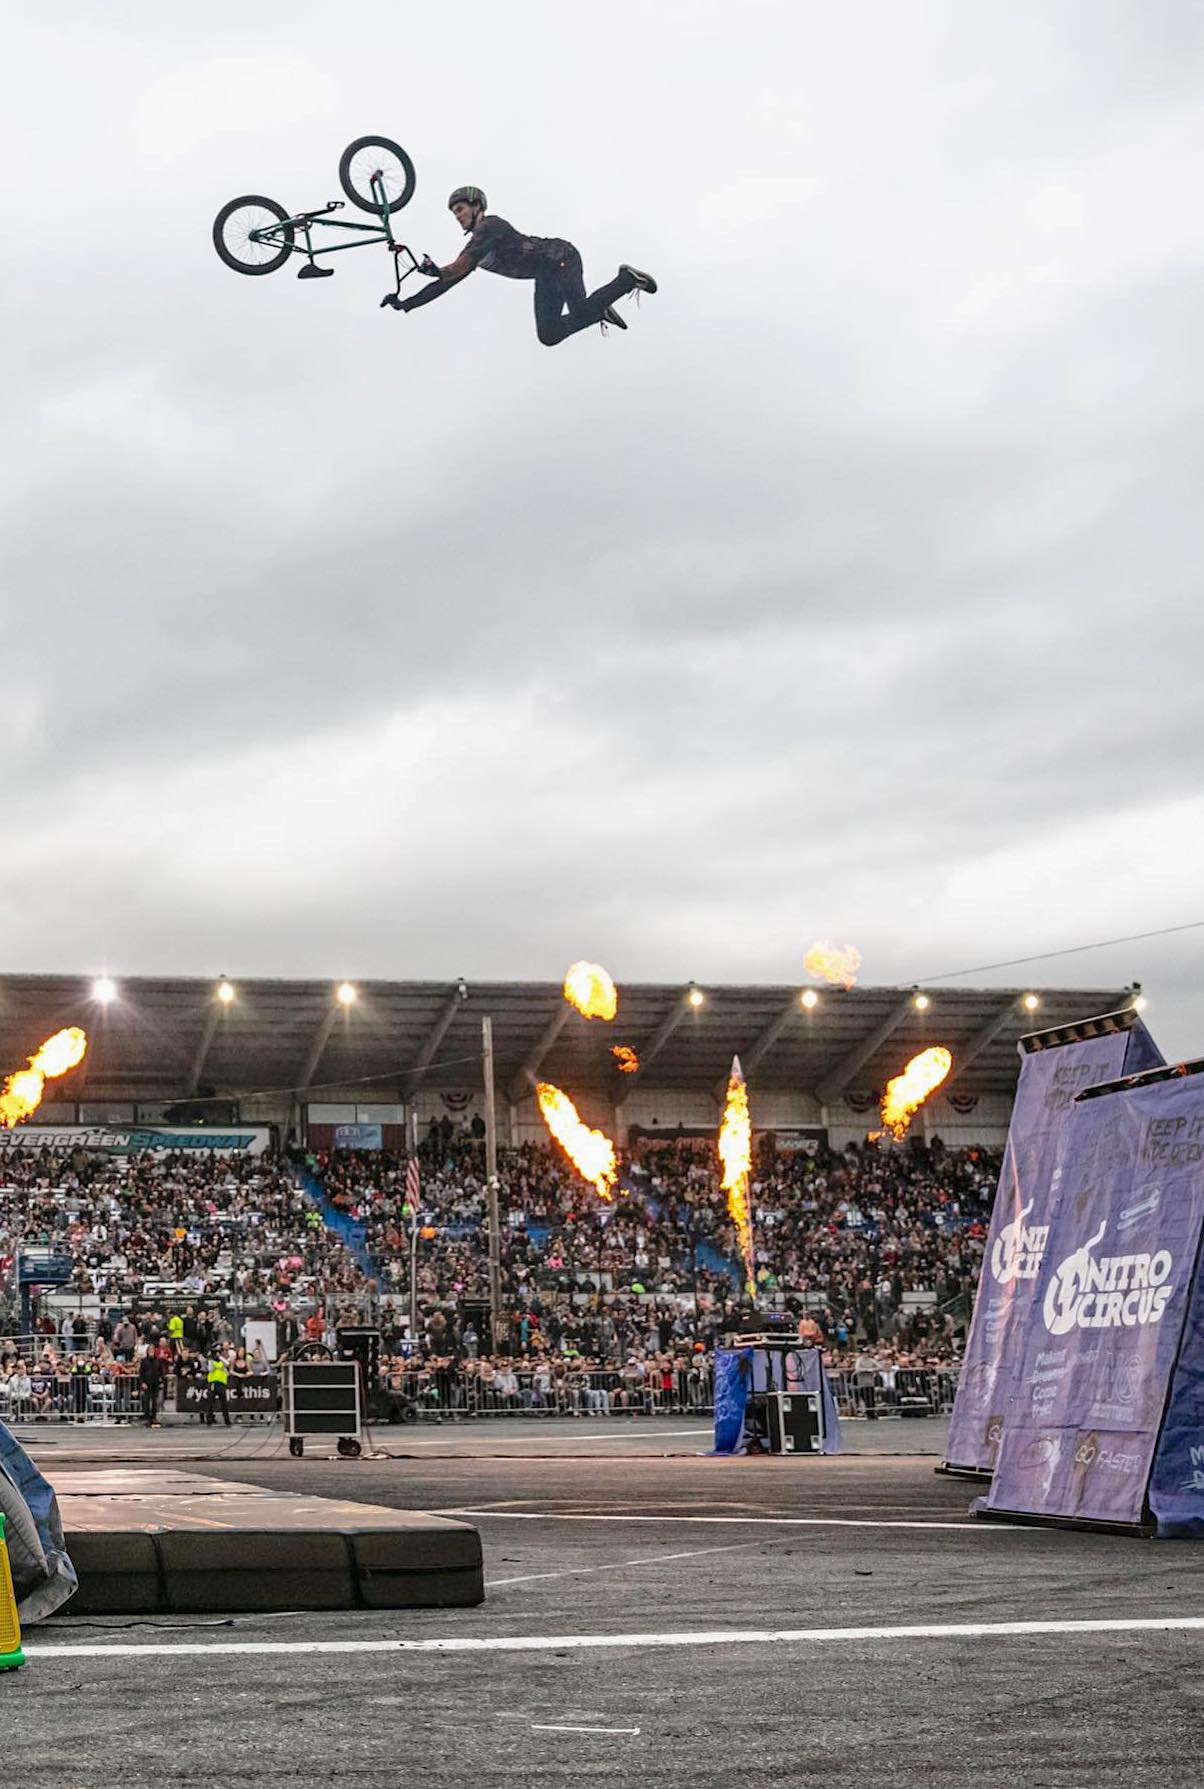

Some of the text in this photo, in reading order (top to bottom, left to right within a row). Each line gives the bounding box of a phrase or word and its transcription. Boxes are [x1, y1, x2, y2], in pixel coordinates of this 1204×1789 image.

[131, 1131, 256, 1149] SPEEDWAY
[1145, 1115, 1188, 1138] KEEP
[1083, 1249, 1173, 1293] NITRO
[1077, 1285, 1172, 1329] CIRCUS
[1075, 1445, 1096, 1465] GO
[1095, 1450, 1142, 1475] FASTER
